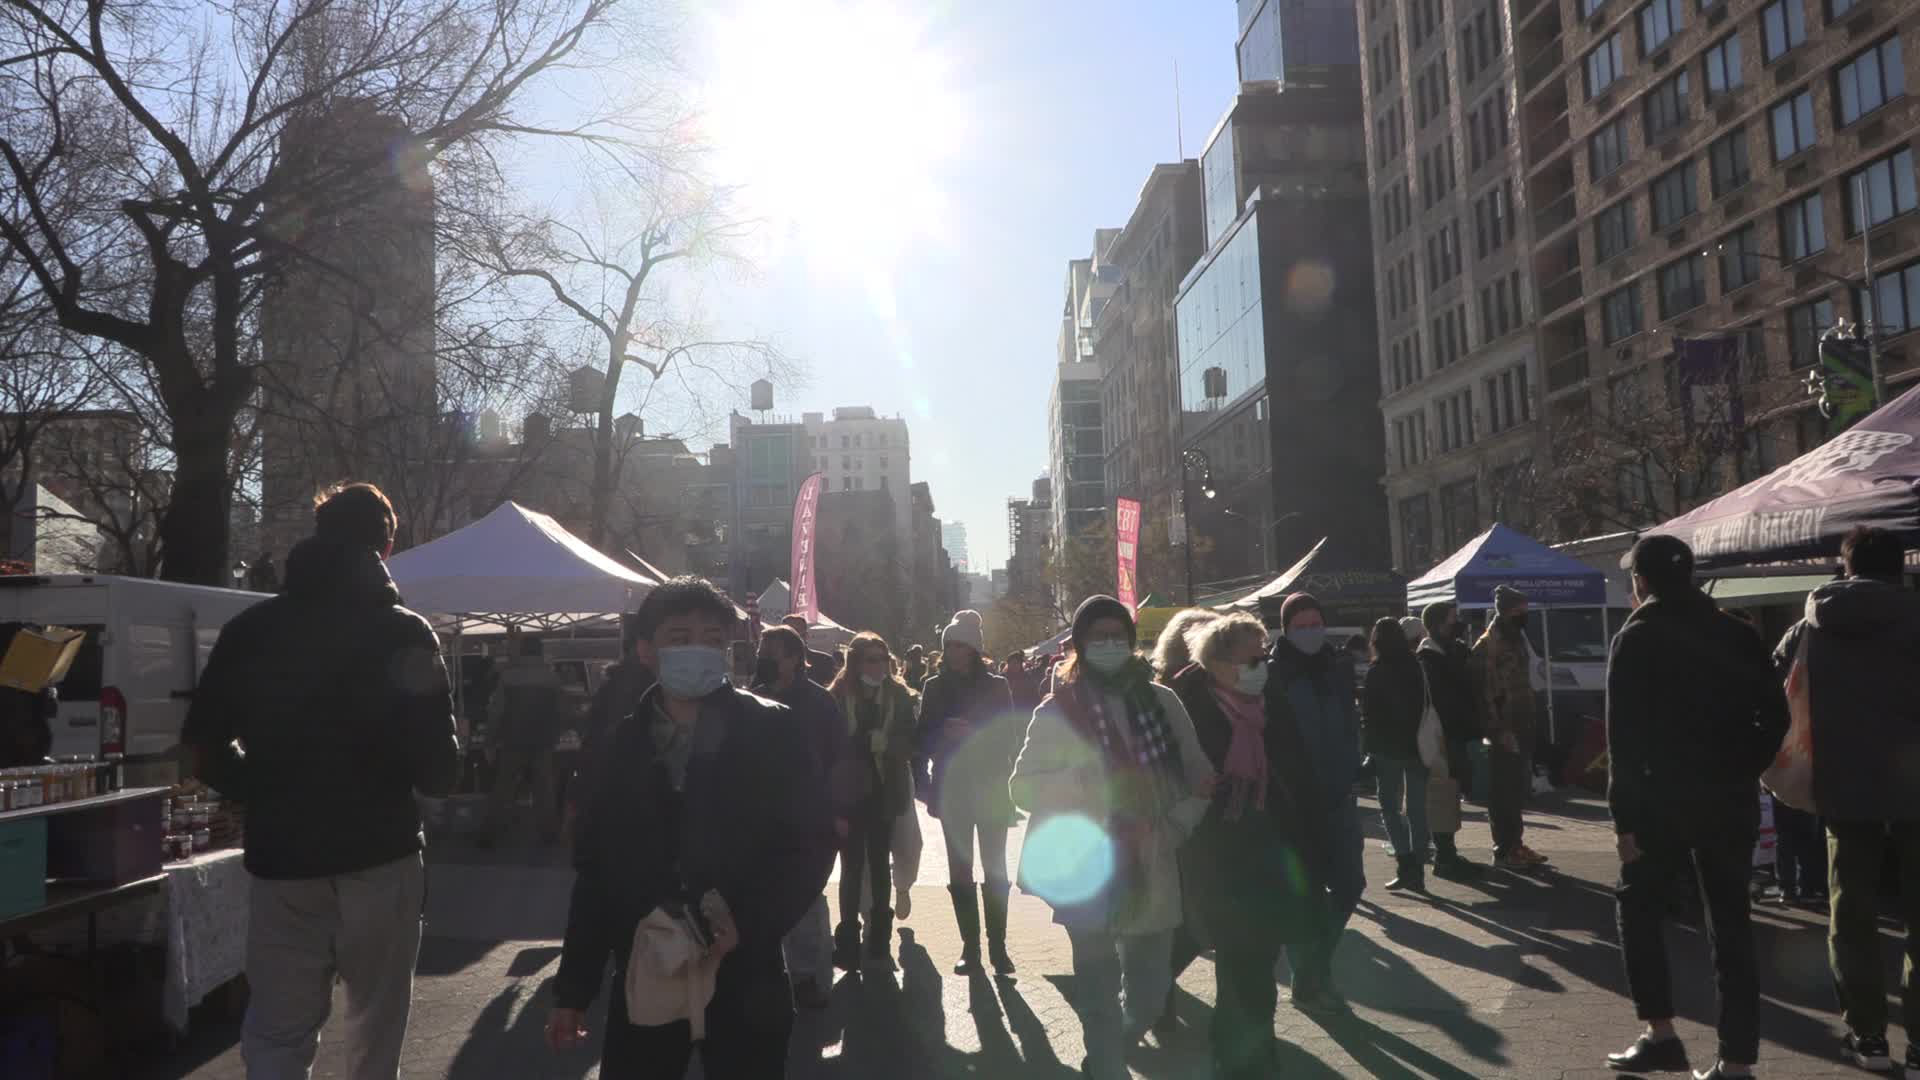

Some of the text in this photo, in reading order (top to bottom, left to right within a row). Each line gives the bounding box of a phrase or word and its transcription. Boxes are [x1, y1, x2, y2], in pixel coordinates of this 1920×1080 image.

[1117, 509, 1136, 532] EBT
[1693, 507, 1827, 555] SHE WOLF BAKERY
